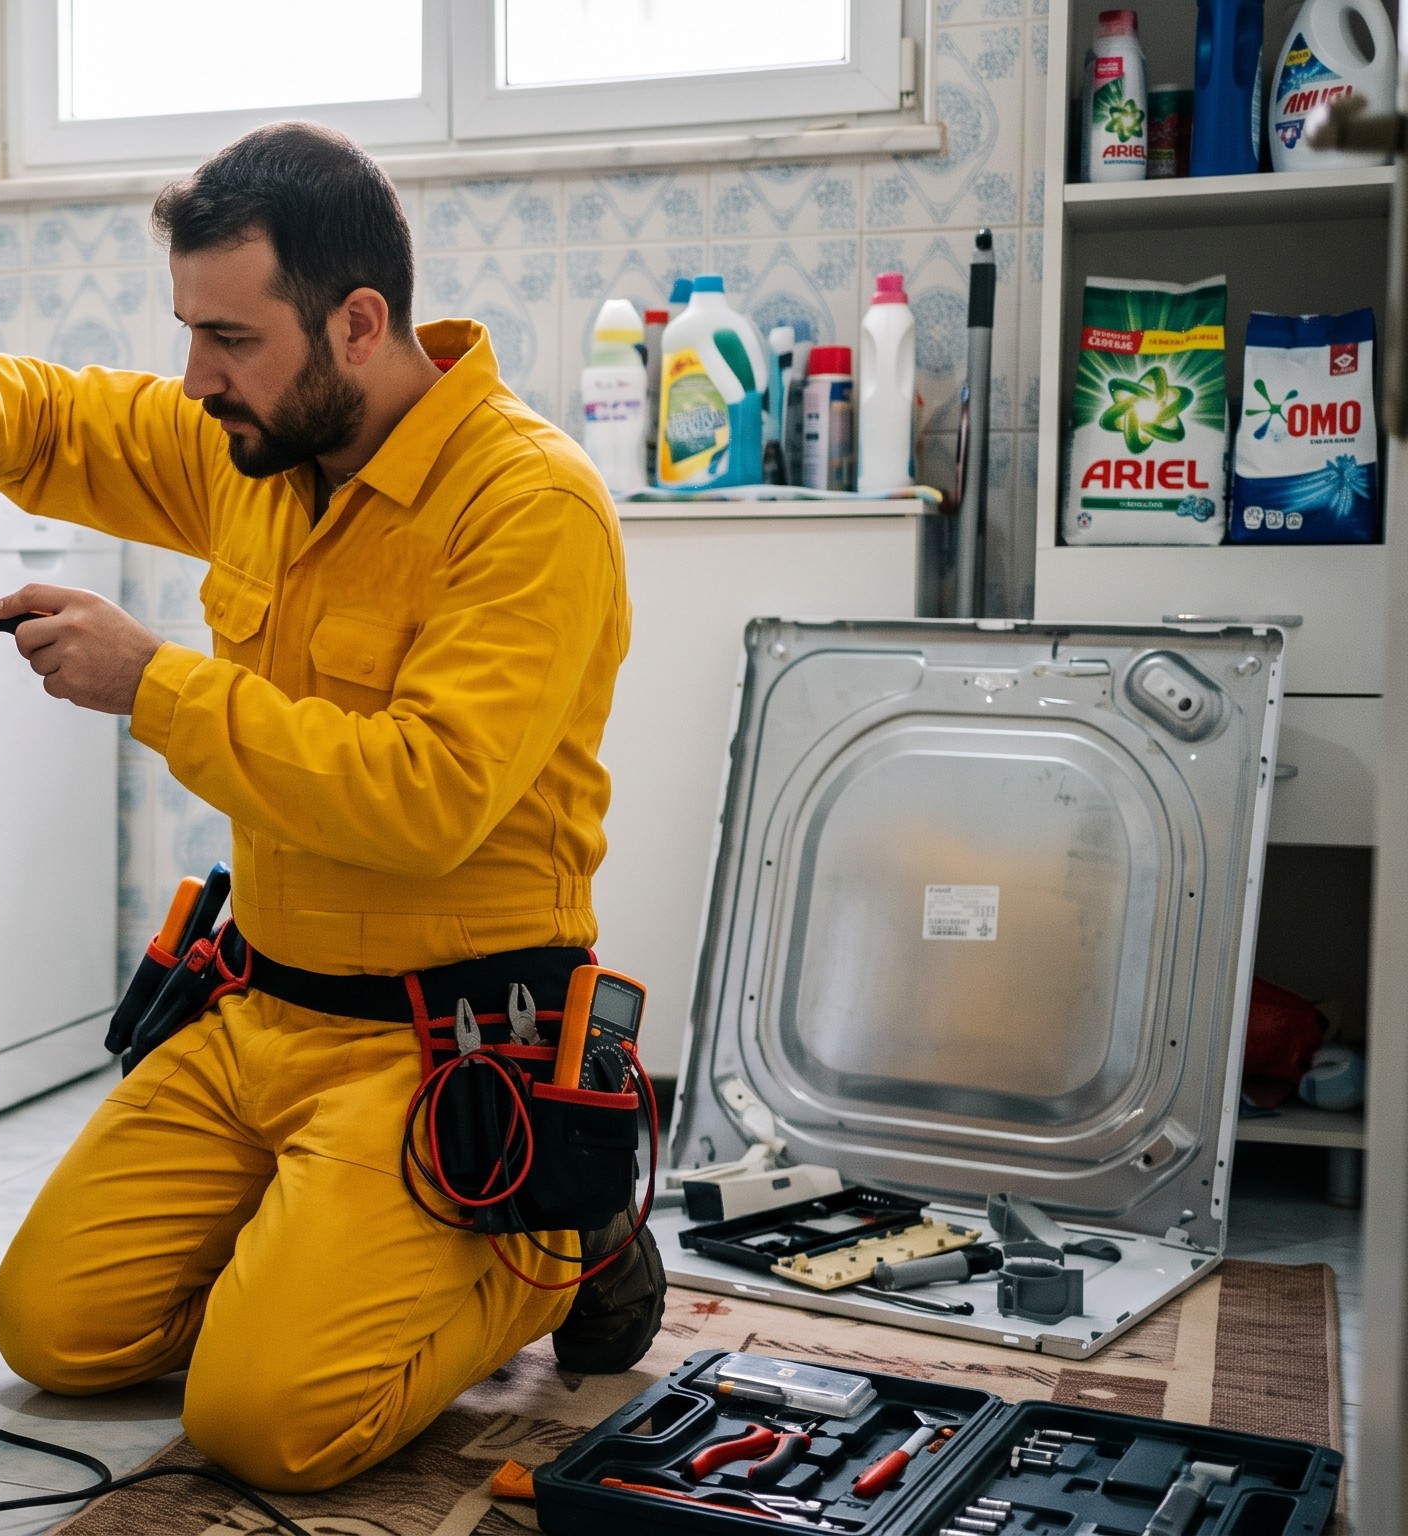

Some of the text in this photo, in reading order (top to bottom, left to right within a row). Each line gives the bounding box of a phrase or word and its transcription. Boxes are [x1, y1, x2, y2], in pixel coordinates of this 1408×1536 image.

[1103, 145, 1146, 158] ARIEL
[1287, 401, 1361, 437] OMO
[1081, 459, 1209, 490] ARIEL
